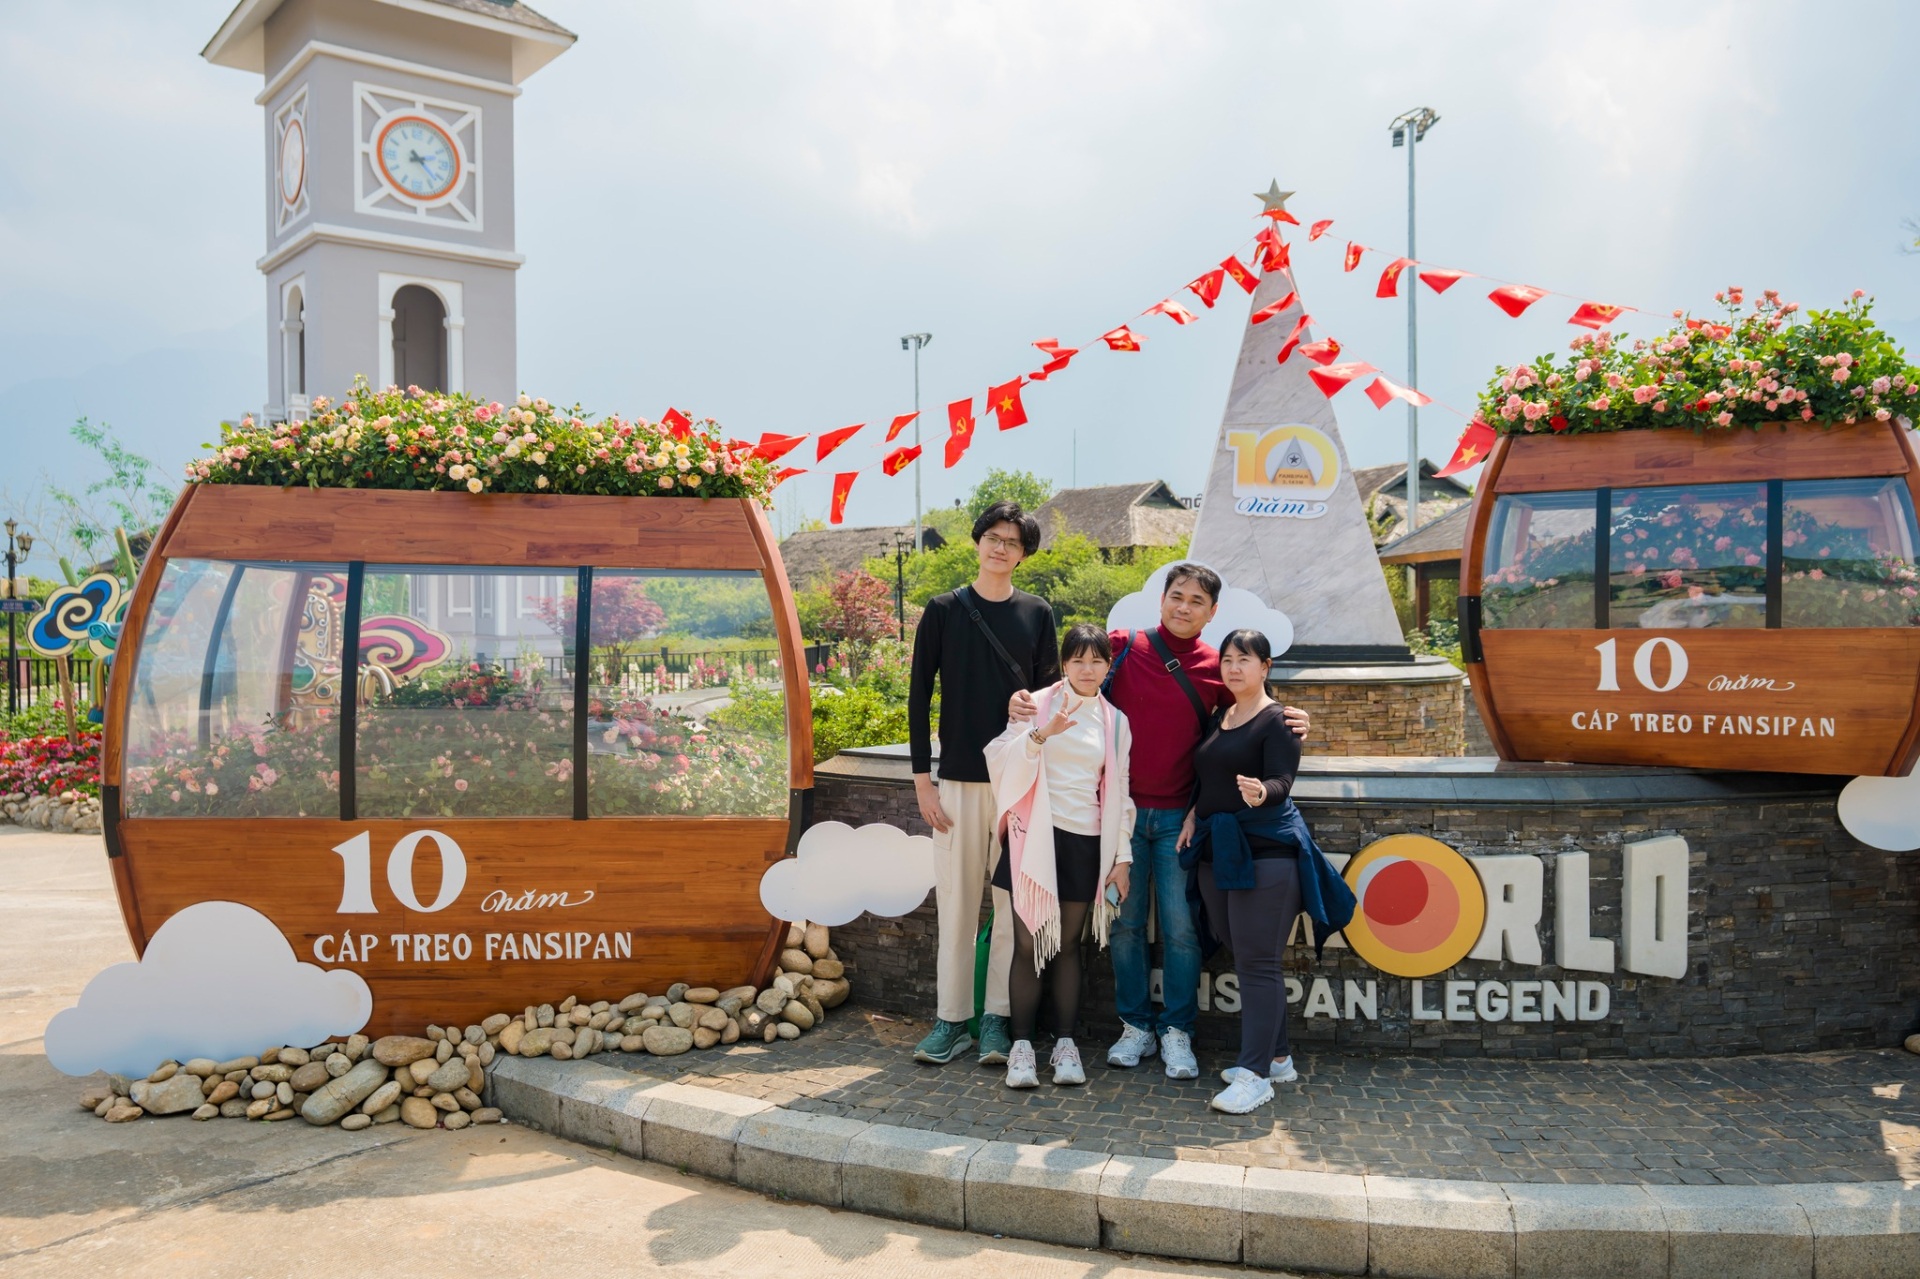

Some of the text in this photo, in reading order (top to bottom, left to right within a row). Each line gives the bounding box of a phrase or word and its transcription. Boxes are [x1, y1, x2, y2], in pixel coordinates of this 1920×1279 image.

[1229, 426, 1338, 489] 10
[1238, 496, 1325, 515] năm
[1594, 636, 1796, 693] 10 năm
[1571, 708, 1836, 738] CÁP TREO FANSIPAN
[330, 829, 595, 914] 10 năm
[312, 929, 632, 963] CÁP TREO FANSIPAN
[1412, 979, 1611, 1022] LEGEND
